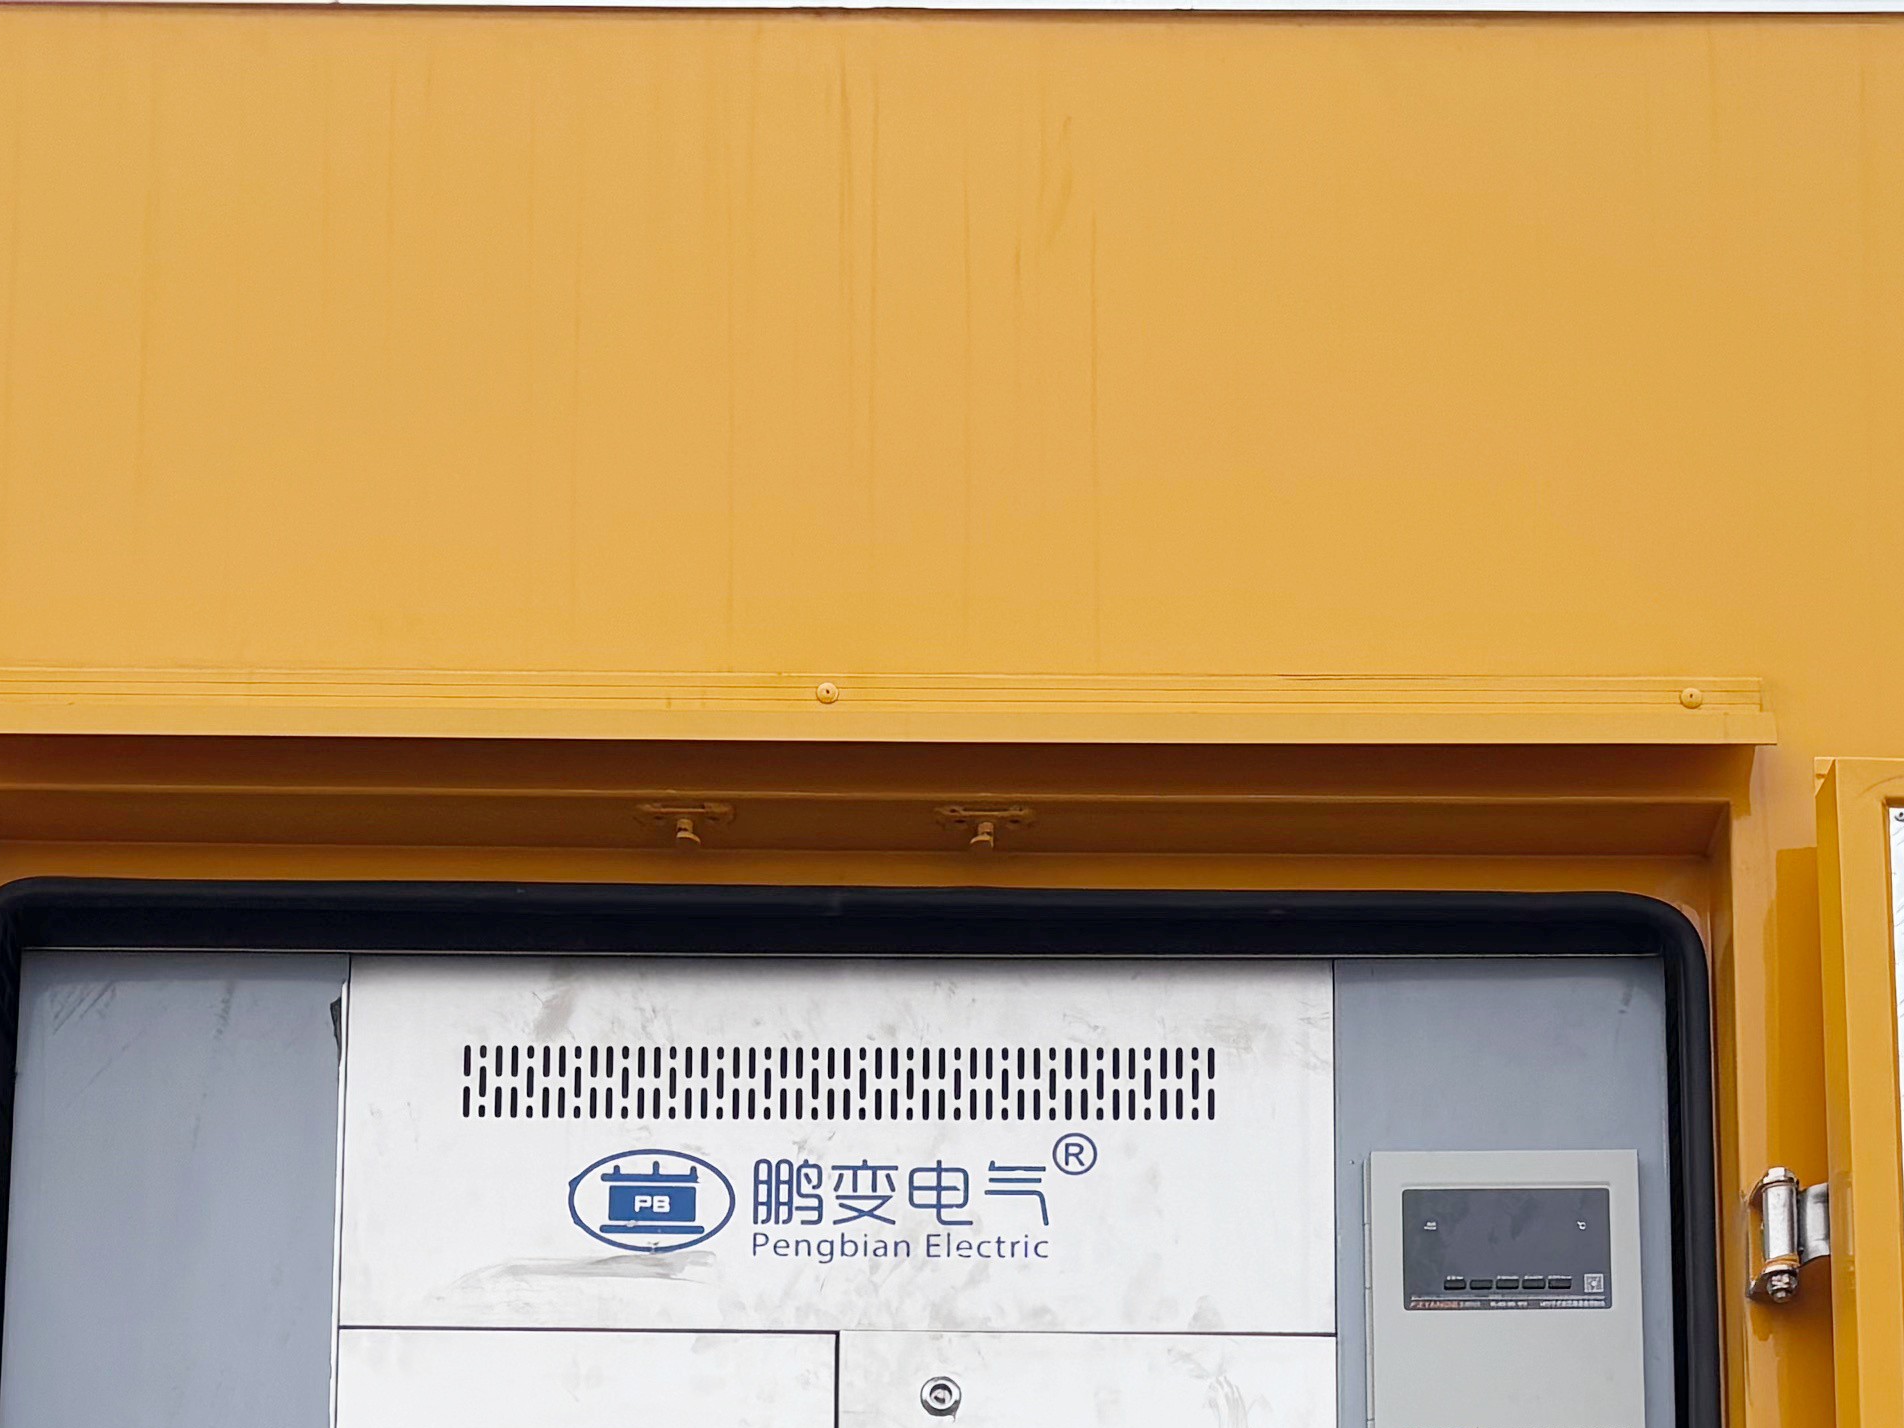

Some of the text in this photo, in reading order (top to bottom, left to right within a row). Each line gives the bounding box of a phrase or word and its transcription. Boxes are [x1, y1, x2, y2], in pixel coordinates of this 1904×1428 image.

[633, 1195, 671, 1214] PB
[752, 1158, 1050, 1227] 鹏变电气
[752, 1232, 1049, 1264] Pengbian Electric
